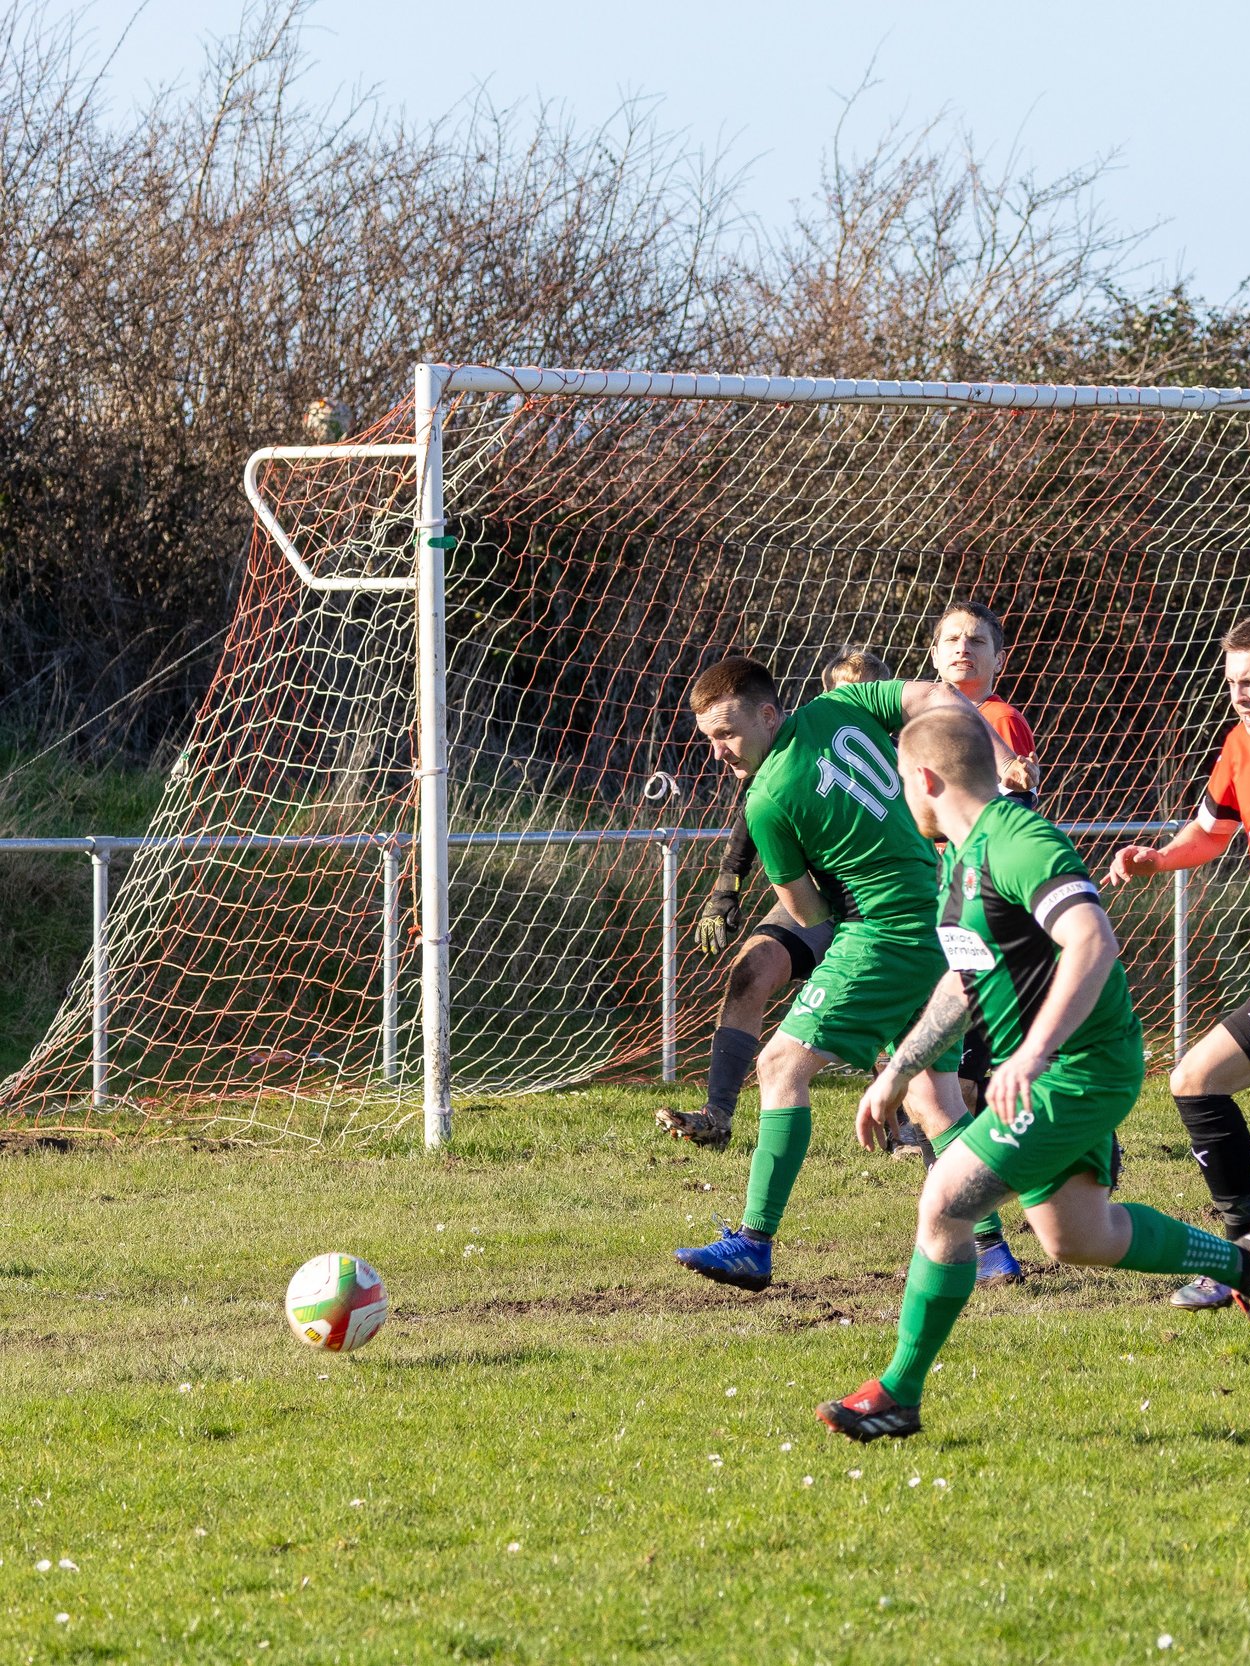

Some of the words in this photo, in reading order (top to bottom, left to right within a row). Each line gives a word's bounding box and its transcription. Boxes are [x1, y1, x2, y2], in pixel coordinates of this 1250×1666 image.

[815, 725, 900, 822] 10
[801, 982, 826, 1009] 10
[1010, 1109, 1035, 1135] 8
